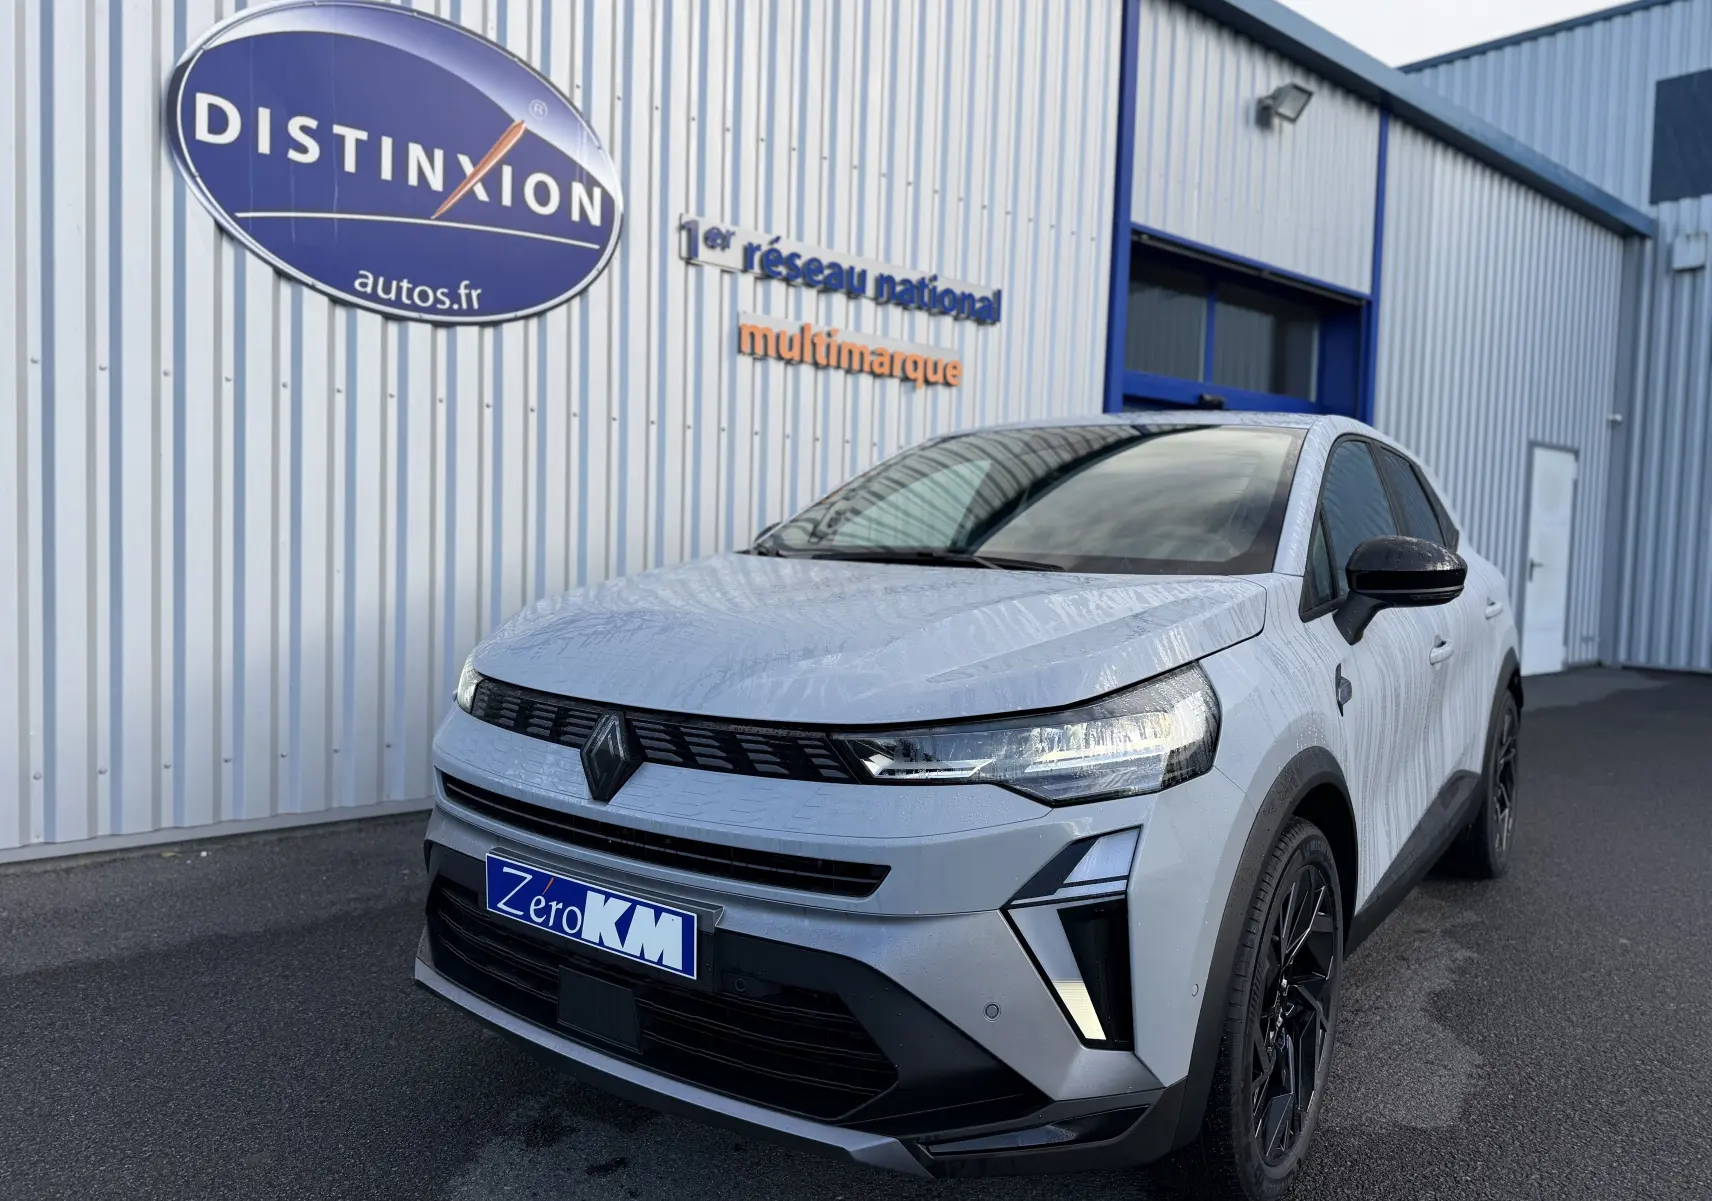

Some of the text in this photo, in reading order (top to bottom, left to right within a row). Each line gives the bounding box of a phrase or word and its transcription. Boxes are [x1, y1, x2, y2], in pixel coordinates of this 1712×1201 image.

[195, 92, 602, 226] DISTINXION
[354, 269, 482, 311] autos.fr
[678, 219, 1002, 325] 1er réseau national
[739, 322, 963, 390] multimarque
